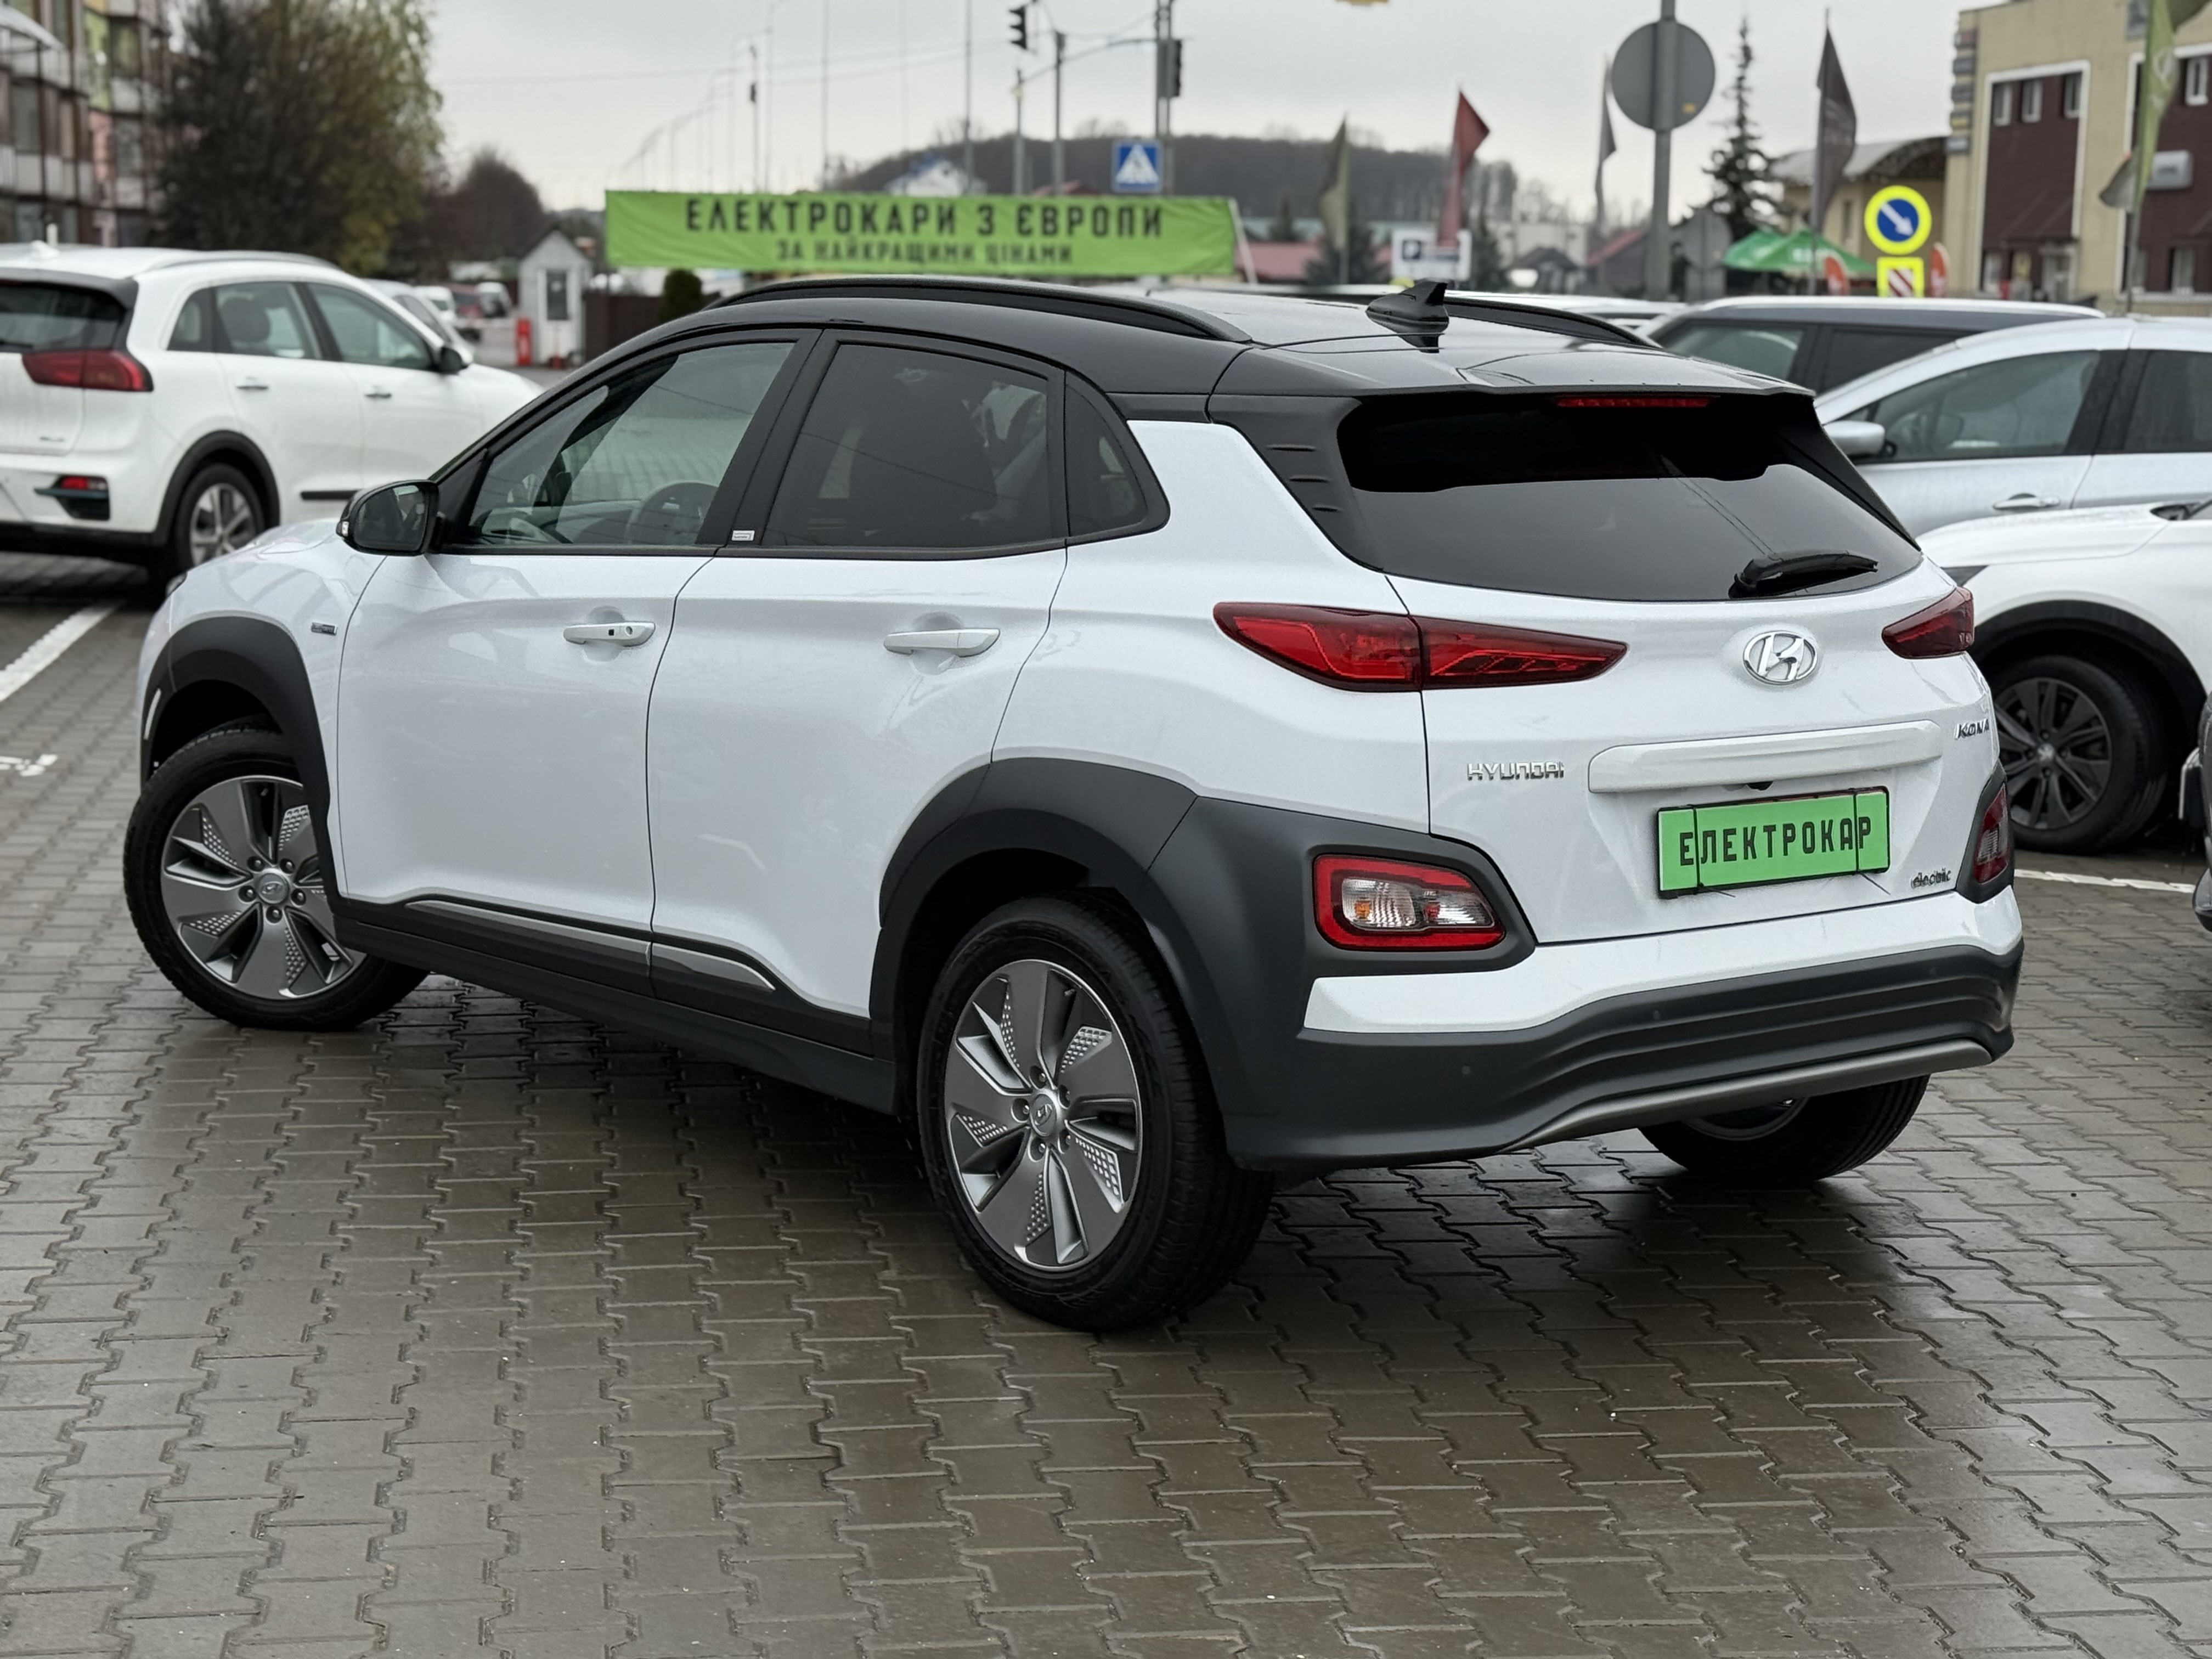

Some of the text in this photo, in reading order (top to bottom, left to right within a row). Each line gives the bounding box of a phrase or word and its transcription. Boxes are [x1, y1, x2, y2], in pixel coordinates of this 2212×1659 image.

[686, 198, 955, 235] ЕЛЕКТРОКАРИ
[1016, 205, 1161, 238] ЄВРОПИ
[777, 238, 1073, 265] ЗА НАЙКРАЩИМИ ЦІНАМИ
[1954, 718, 1989, 740] KONA
[1467, 761, 1565, 781] HYUNDAI
[1680, 816, 1872, 866] ЕЛЕКТРОКАР
